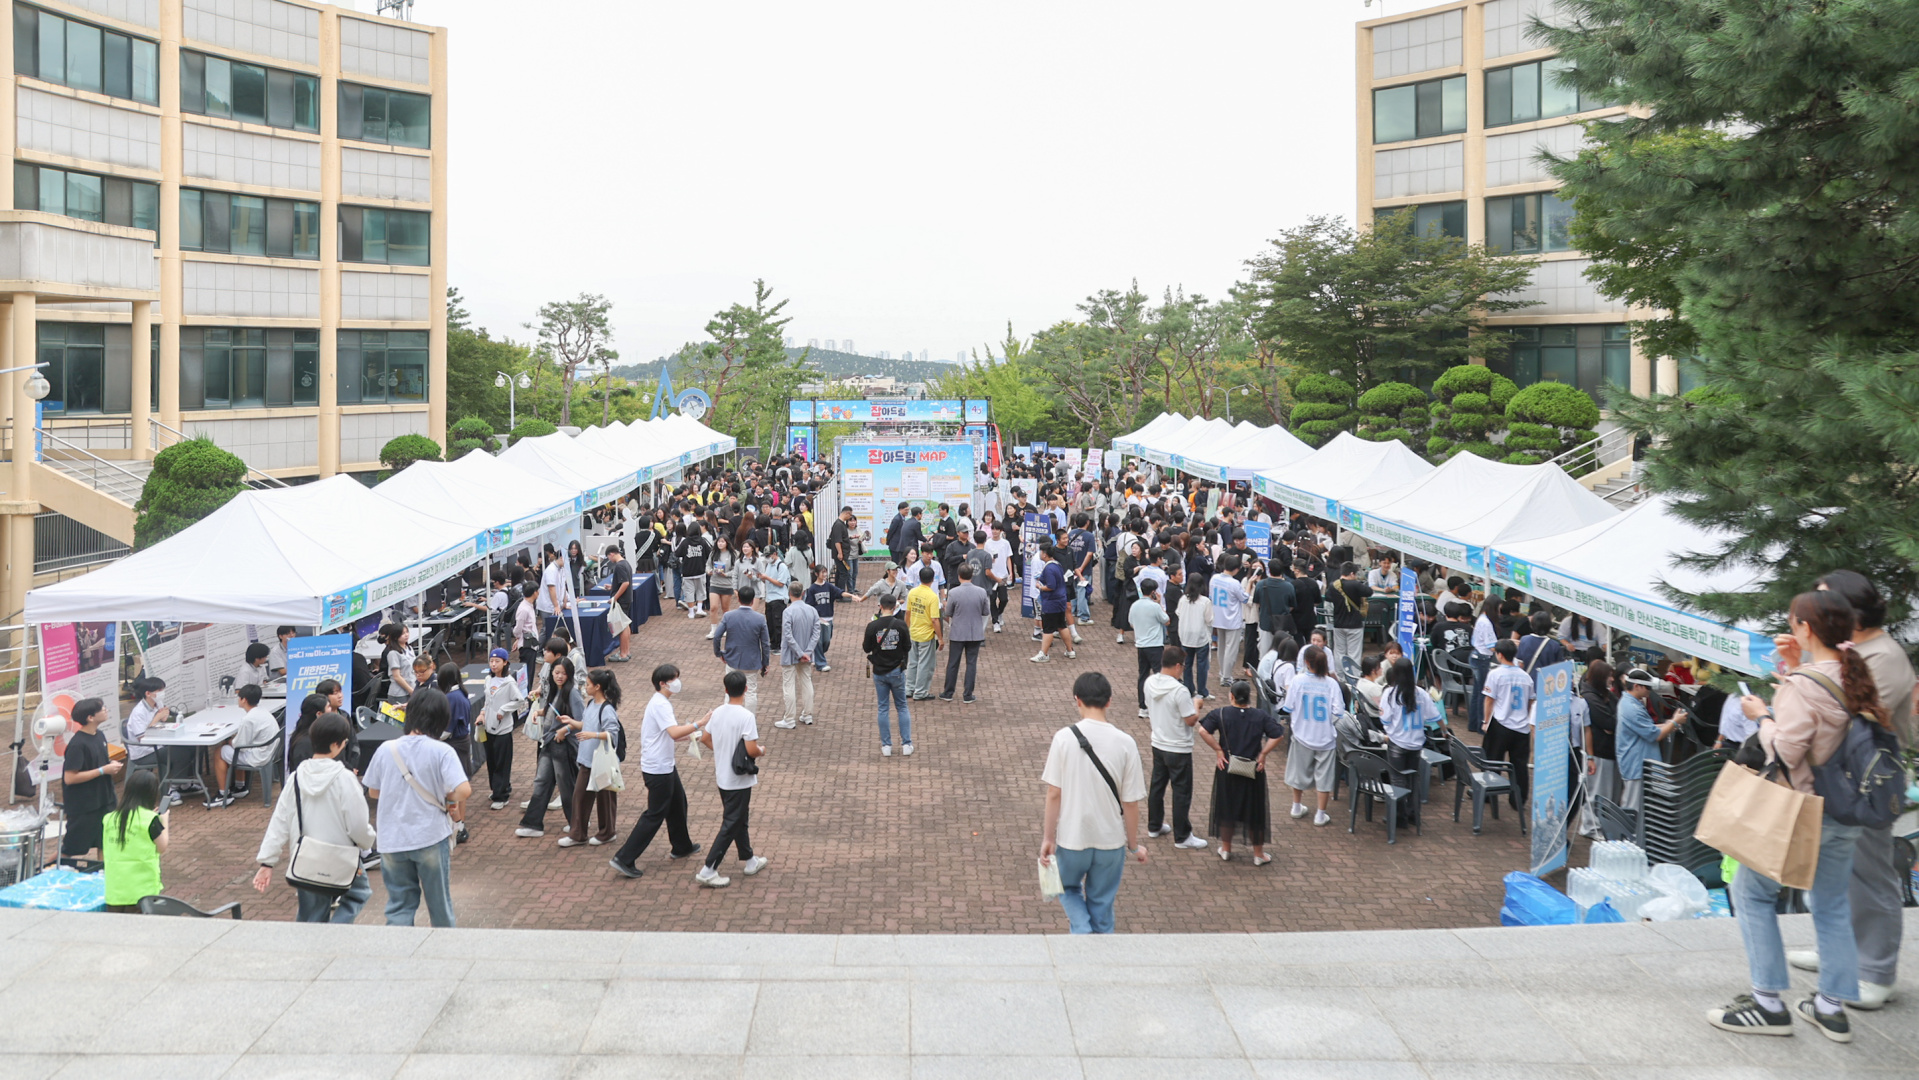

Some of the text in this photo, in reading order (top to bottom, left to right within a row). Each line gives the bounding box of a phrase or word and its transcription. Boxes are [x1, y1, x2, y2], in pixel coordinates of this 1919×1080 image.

[871, 405, 906, 417] 잡아드림
[867, 449, 948, 465] 잡아드림 MAP
[372, 585, 388, 602] 디미고
[1213, 587, 1228, 608] 12
[1573, 589, 1602, 611] 경험하는
[1603, 599, 1635, 622] 미래기술
[1637, 610, 1709, 646] 안산공업고등학교
[1710, 633, 1740, 656] 체험관
[298, 663, 340, 676] 대한민국
[1511, 685, 1523, 710] 3
[1302, 694, 1327, 722] 16
